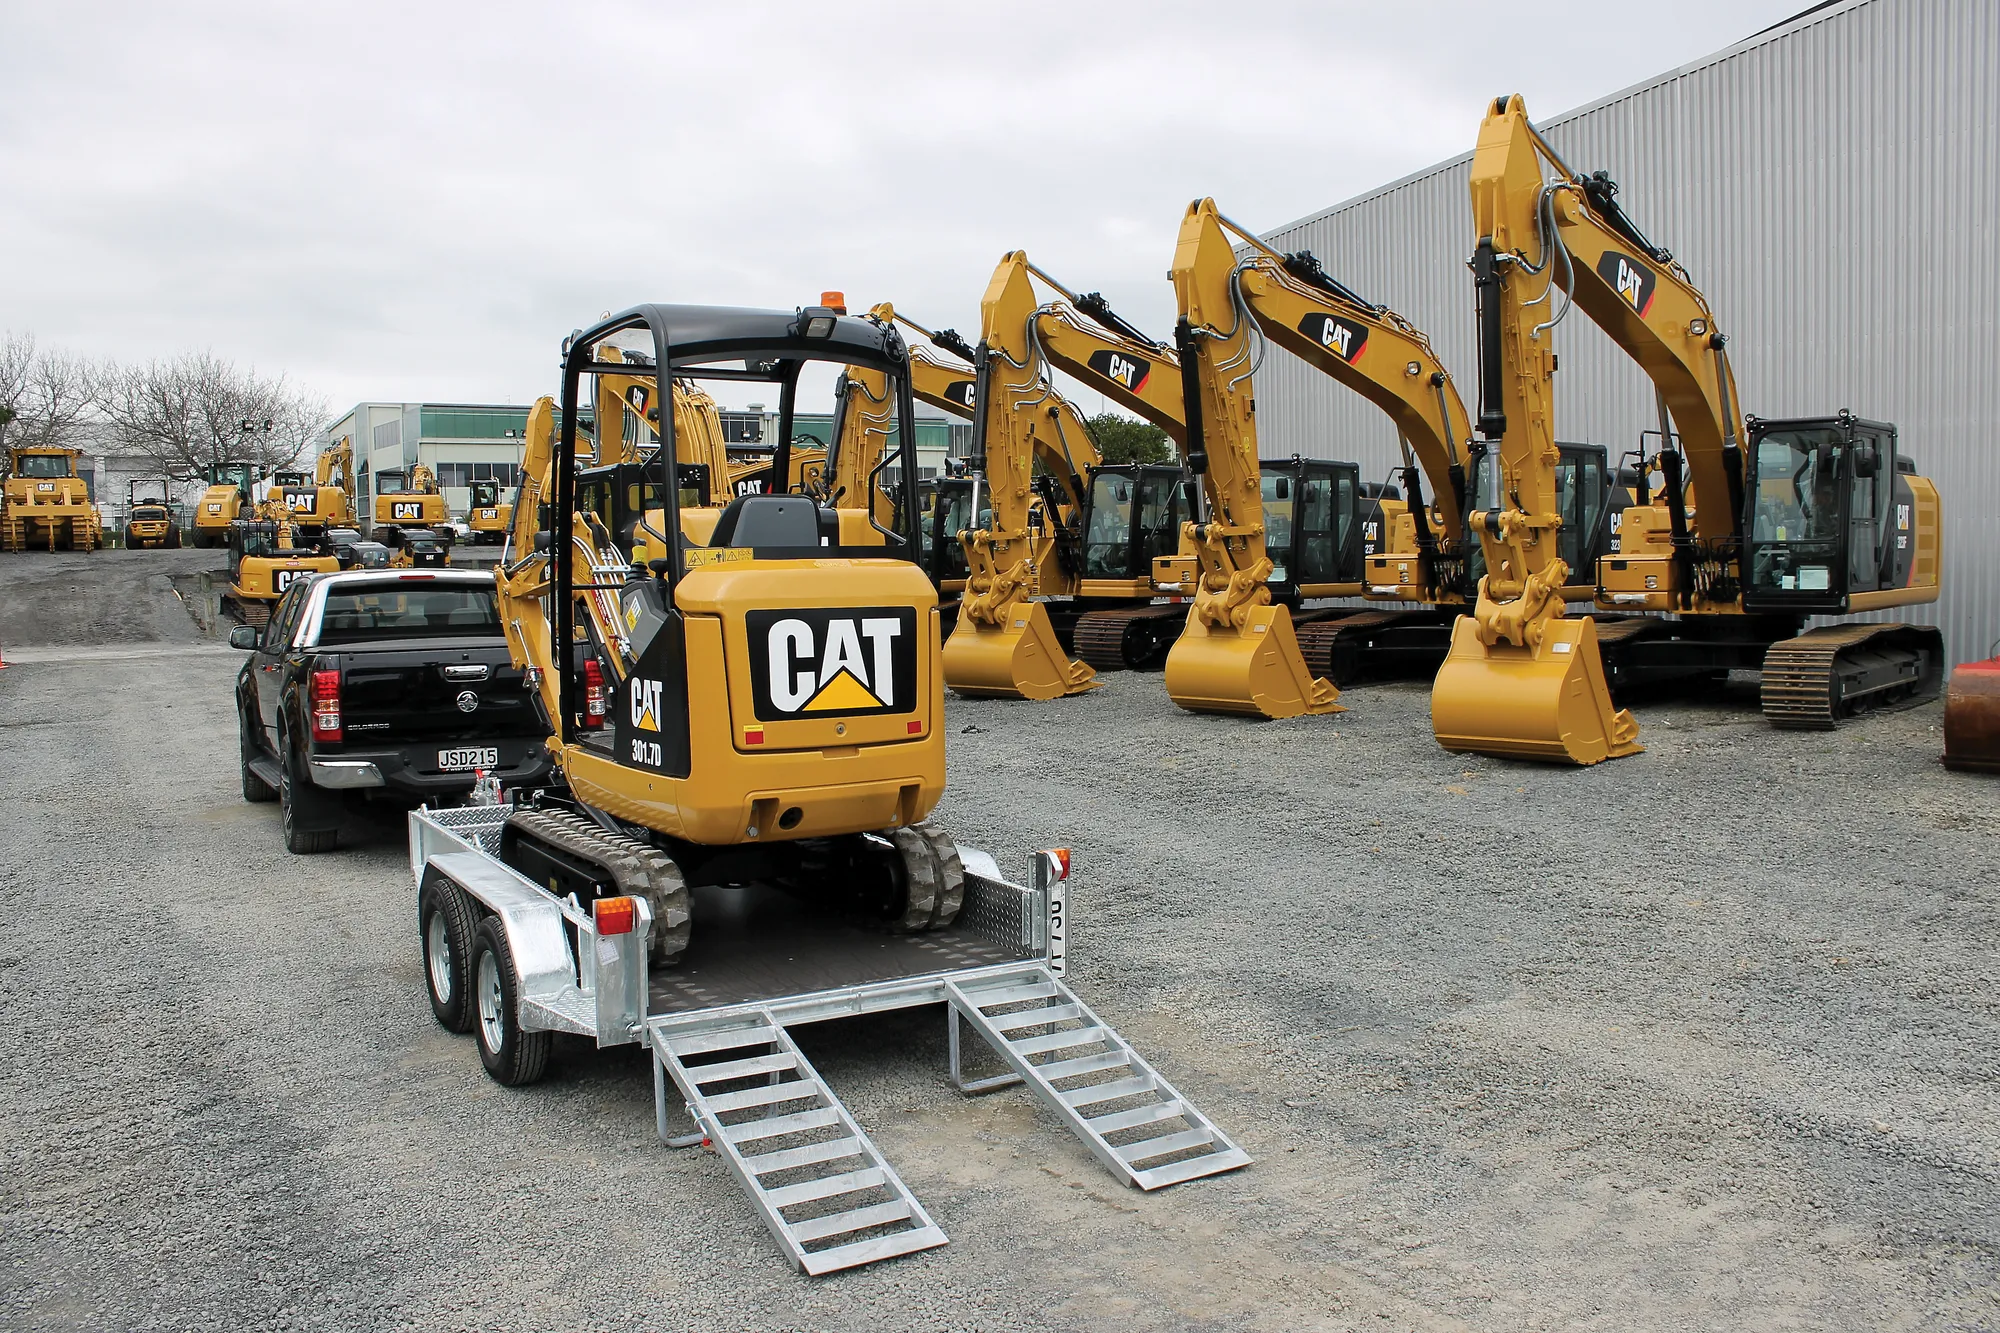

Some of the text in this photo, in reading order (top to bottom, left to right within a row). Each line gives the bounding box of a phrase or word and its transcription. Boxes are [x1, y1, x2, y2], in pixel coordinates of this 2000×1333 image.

[1617, 258, 1642, 309] CAT
[1322, 317, 1352, 357] CAT
[1109, 353, 1136, 388] CAT
[632, 387, 643, 411] CAT
[38, 483, 54, 492] CAT
[737, 479, 762, 497] CAT
[208, 504, 221, 512] CAT
[285, 494, 315, 513] CAT
[394, 503, 420, 519] CAT
[482, 510, 497, 519] CAT
[1610, 512, 1623, 535] CA
[1897, 504, 1909, 530] CAT
[1364, 544, 1375, 554] 23F
[1610, 539, 1621, 551] 323
[768, 617, 901, 712] CAT
[631, 677, 663, 733] CAT
[440, 749, 496, 766] JSD215
[631, 738, 662, 767] 301.7D
